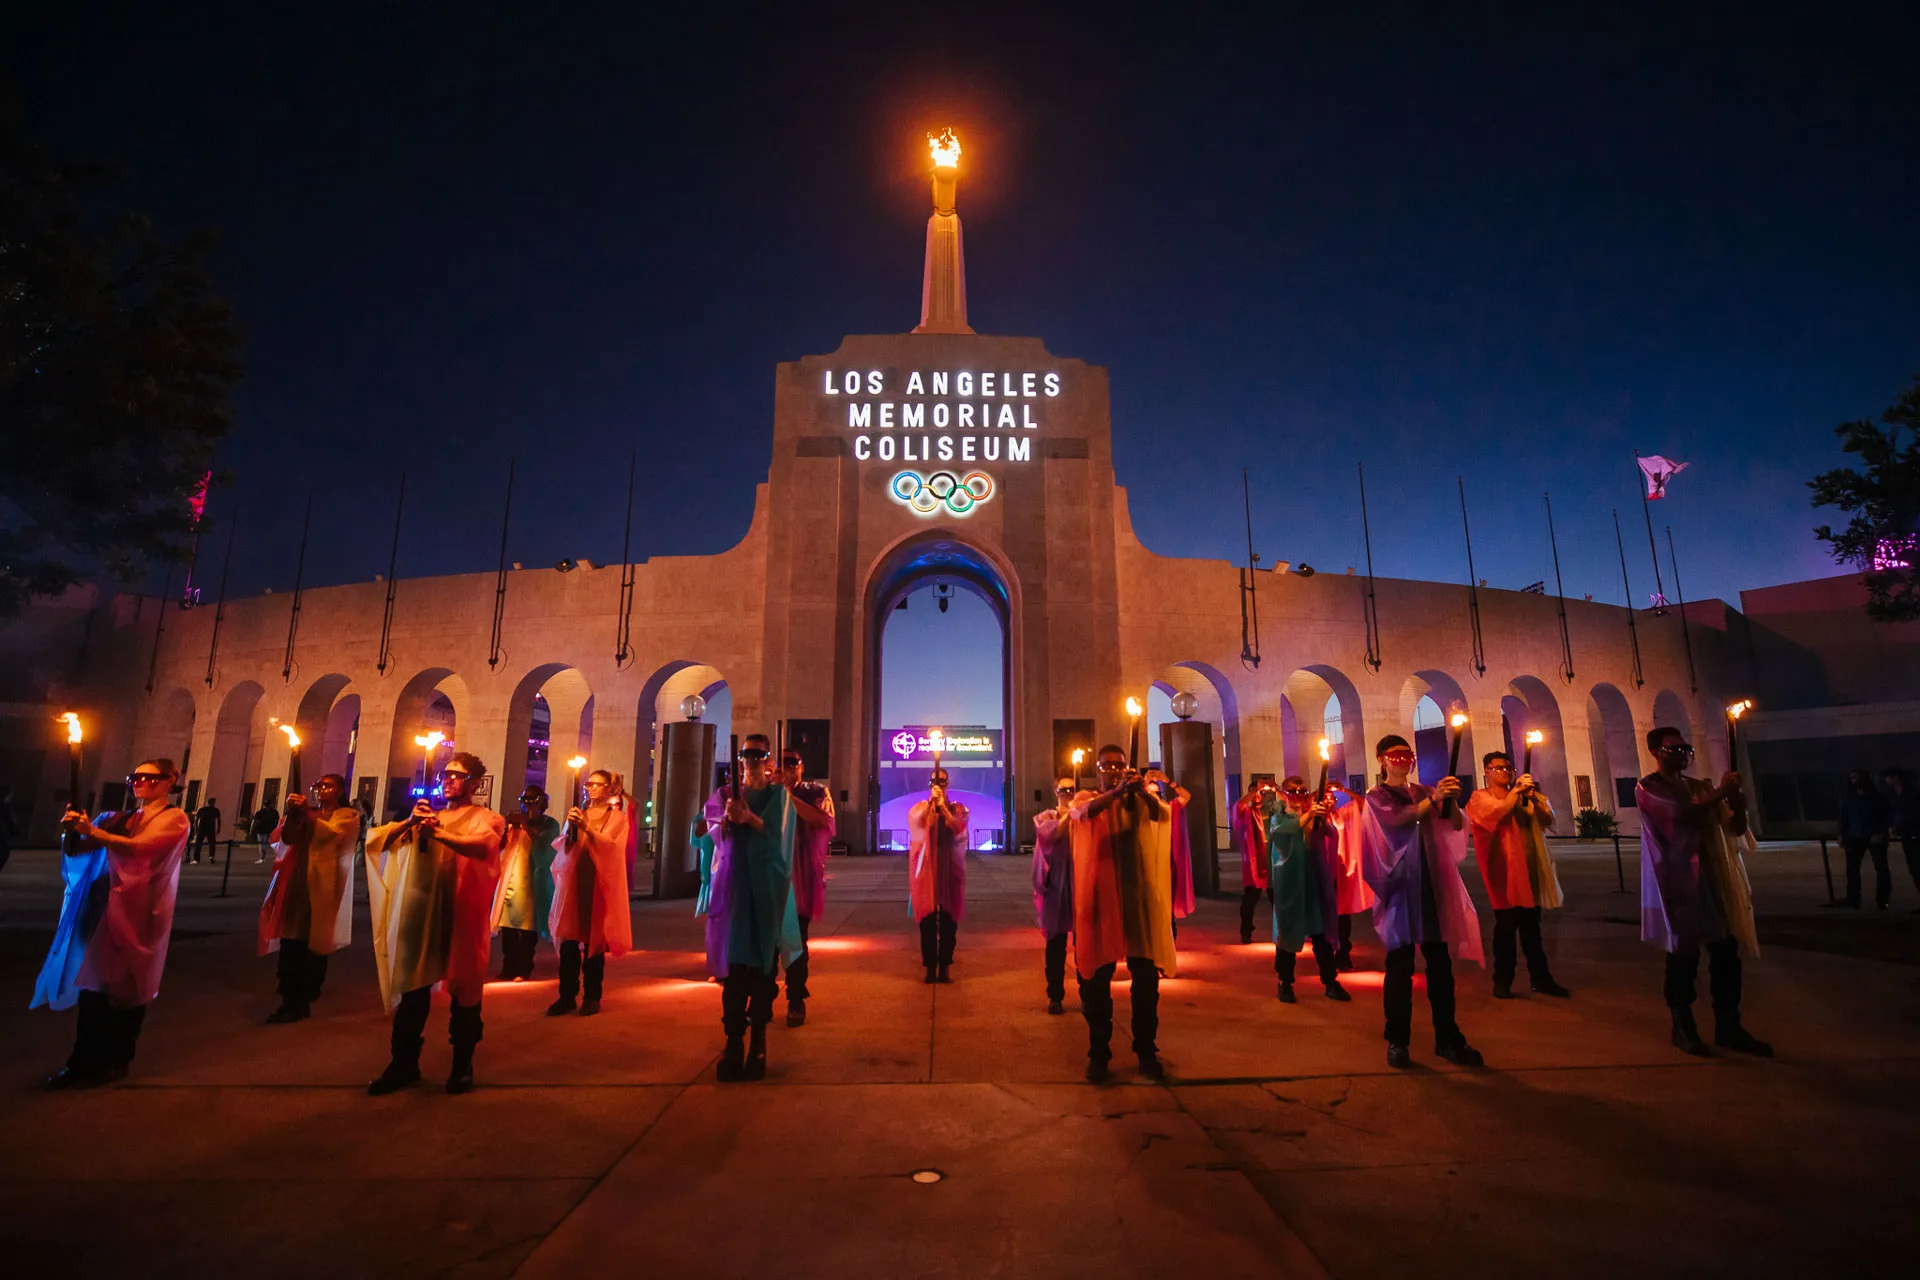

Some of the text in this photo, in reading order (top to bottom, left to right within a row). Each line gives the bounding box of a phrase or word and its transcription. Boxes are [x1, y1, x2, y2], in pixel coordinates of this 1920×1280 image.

[825, 370, 1060, 397] LOS ANGELES
[849, 403, 1038, 428] MEMORIAL
[855, 436, 1030, 461] COLISEUM
